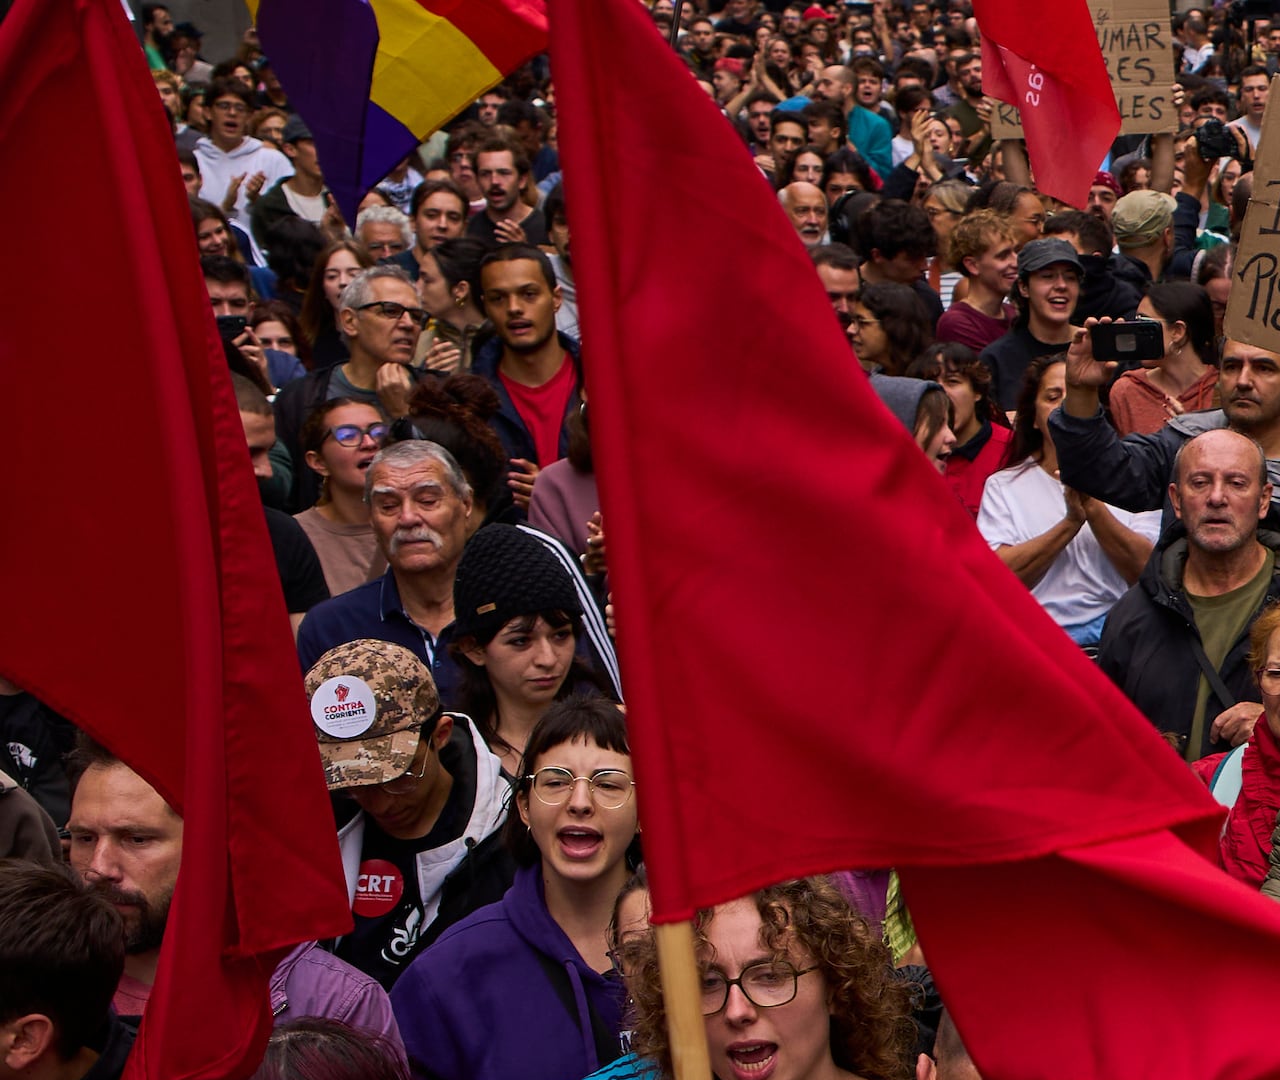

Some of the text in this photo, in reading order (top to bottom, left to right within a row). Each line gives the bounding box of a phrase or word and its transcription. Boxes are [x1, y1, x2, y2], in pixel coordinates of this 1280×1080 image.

[1096, 22, 1166, 52] UMAR
[323, 700, 365, 714] CONTRA
[325, 708, 367, 721] CORRIENTE
[357, 874, 396, 894] CRT
